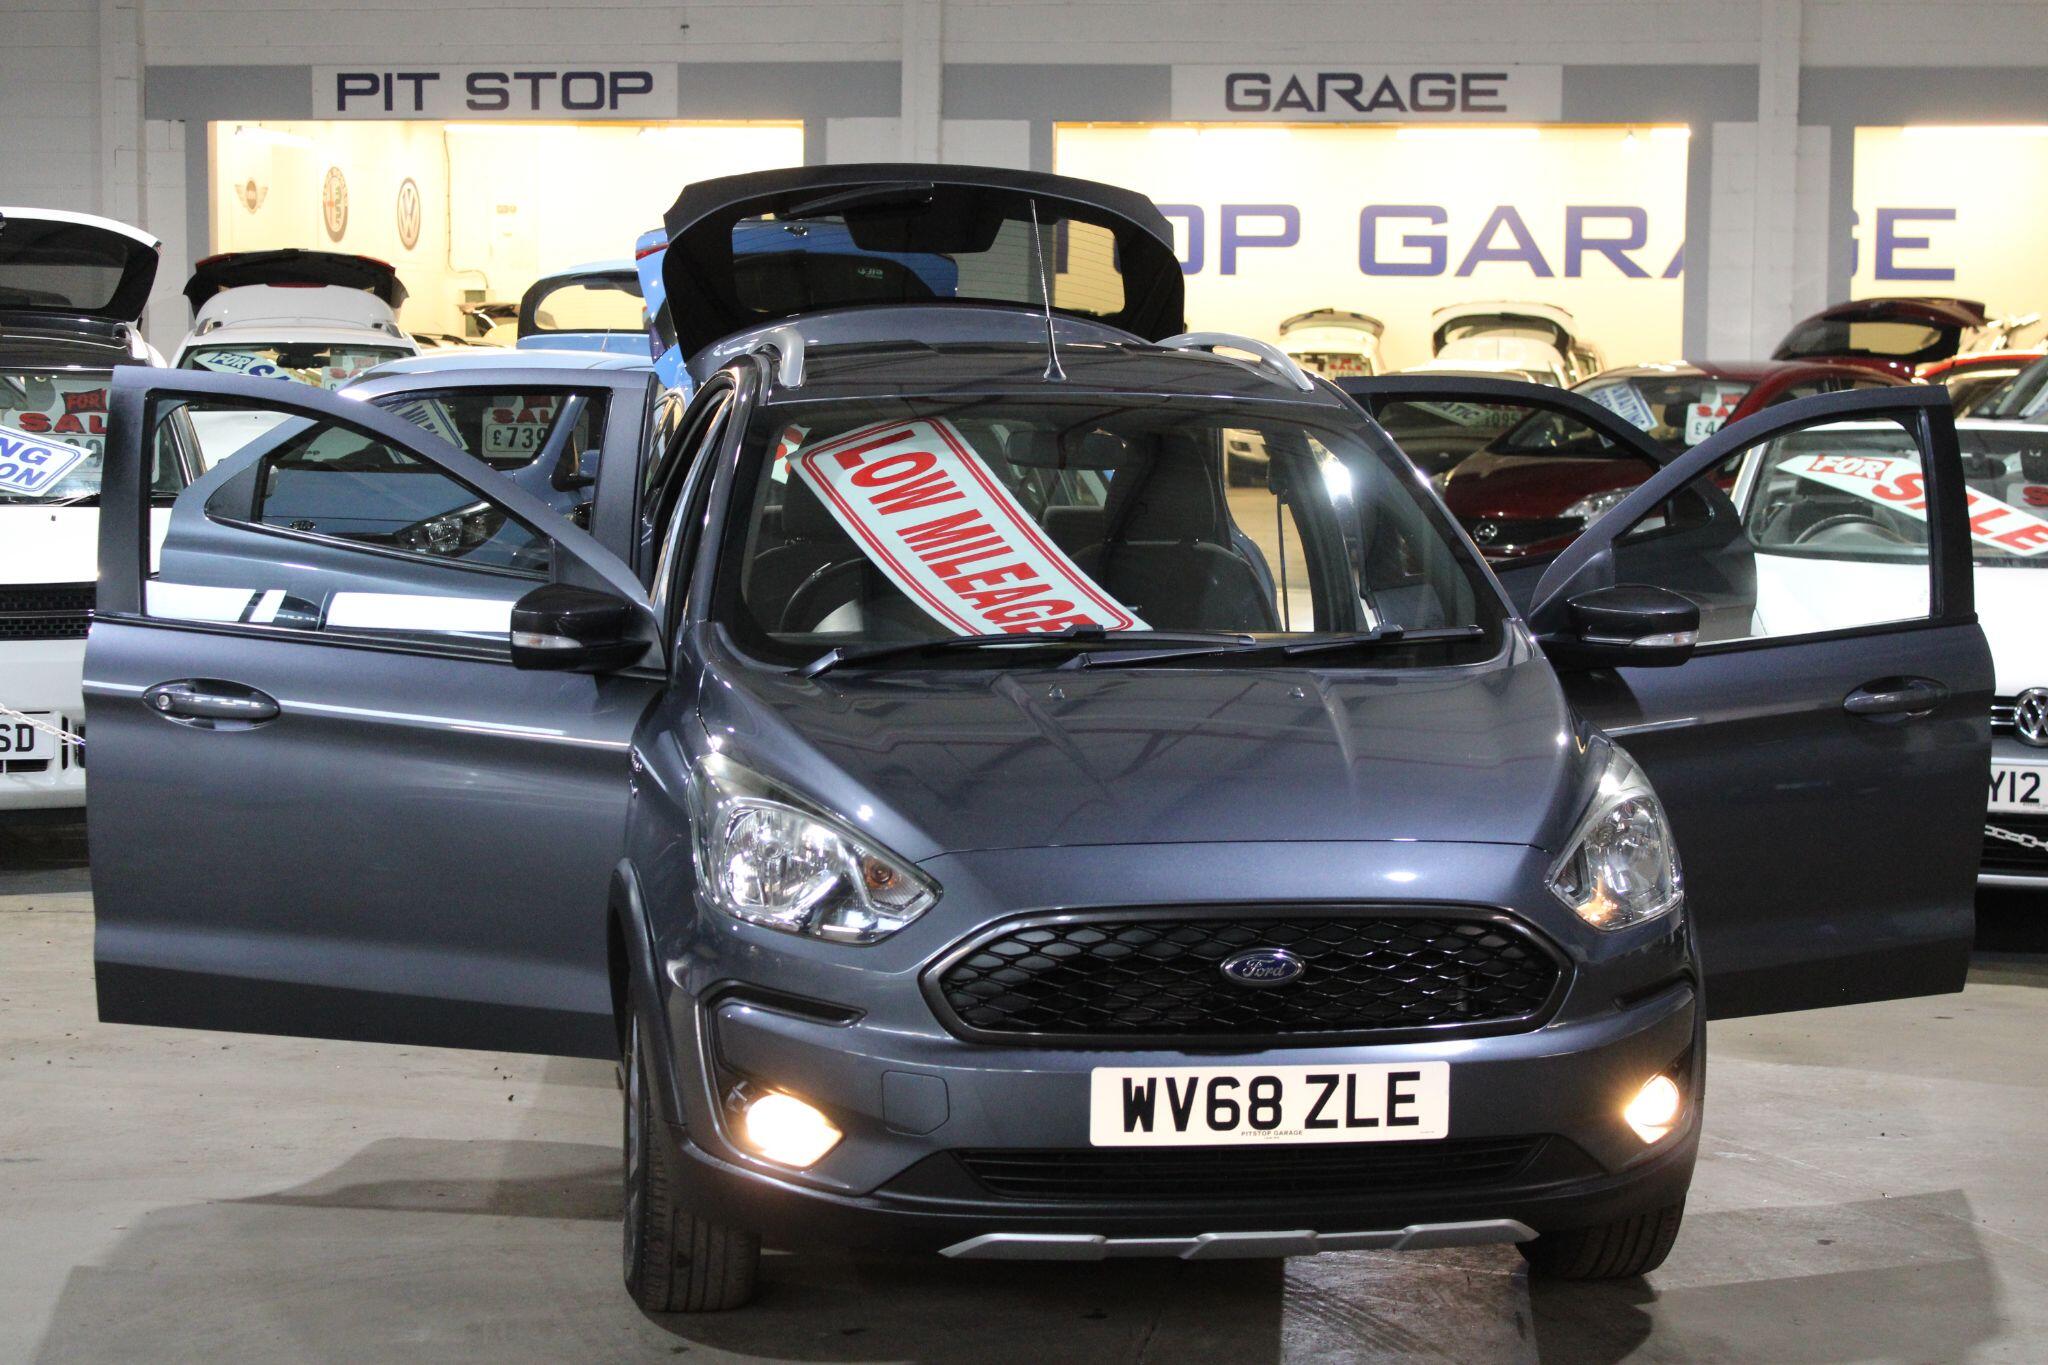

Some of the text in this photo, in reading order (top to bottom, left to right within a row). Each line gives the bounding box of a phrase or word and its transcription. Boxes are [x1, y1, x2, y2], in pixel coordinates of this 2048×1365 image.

[337, 71, 653, 111] PIT STOP
[1225, 73, 1508, 112] GARAGE
[212, 352, 250, 371] FOR
[1813, 456, 1887, 478] FOR
[833, 429, 1098, 634] LOW MILEAGE
[1242, 959, 1286, 977] Ford
[1122, 1071, 1420, 1133] WV68 ZLE
